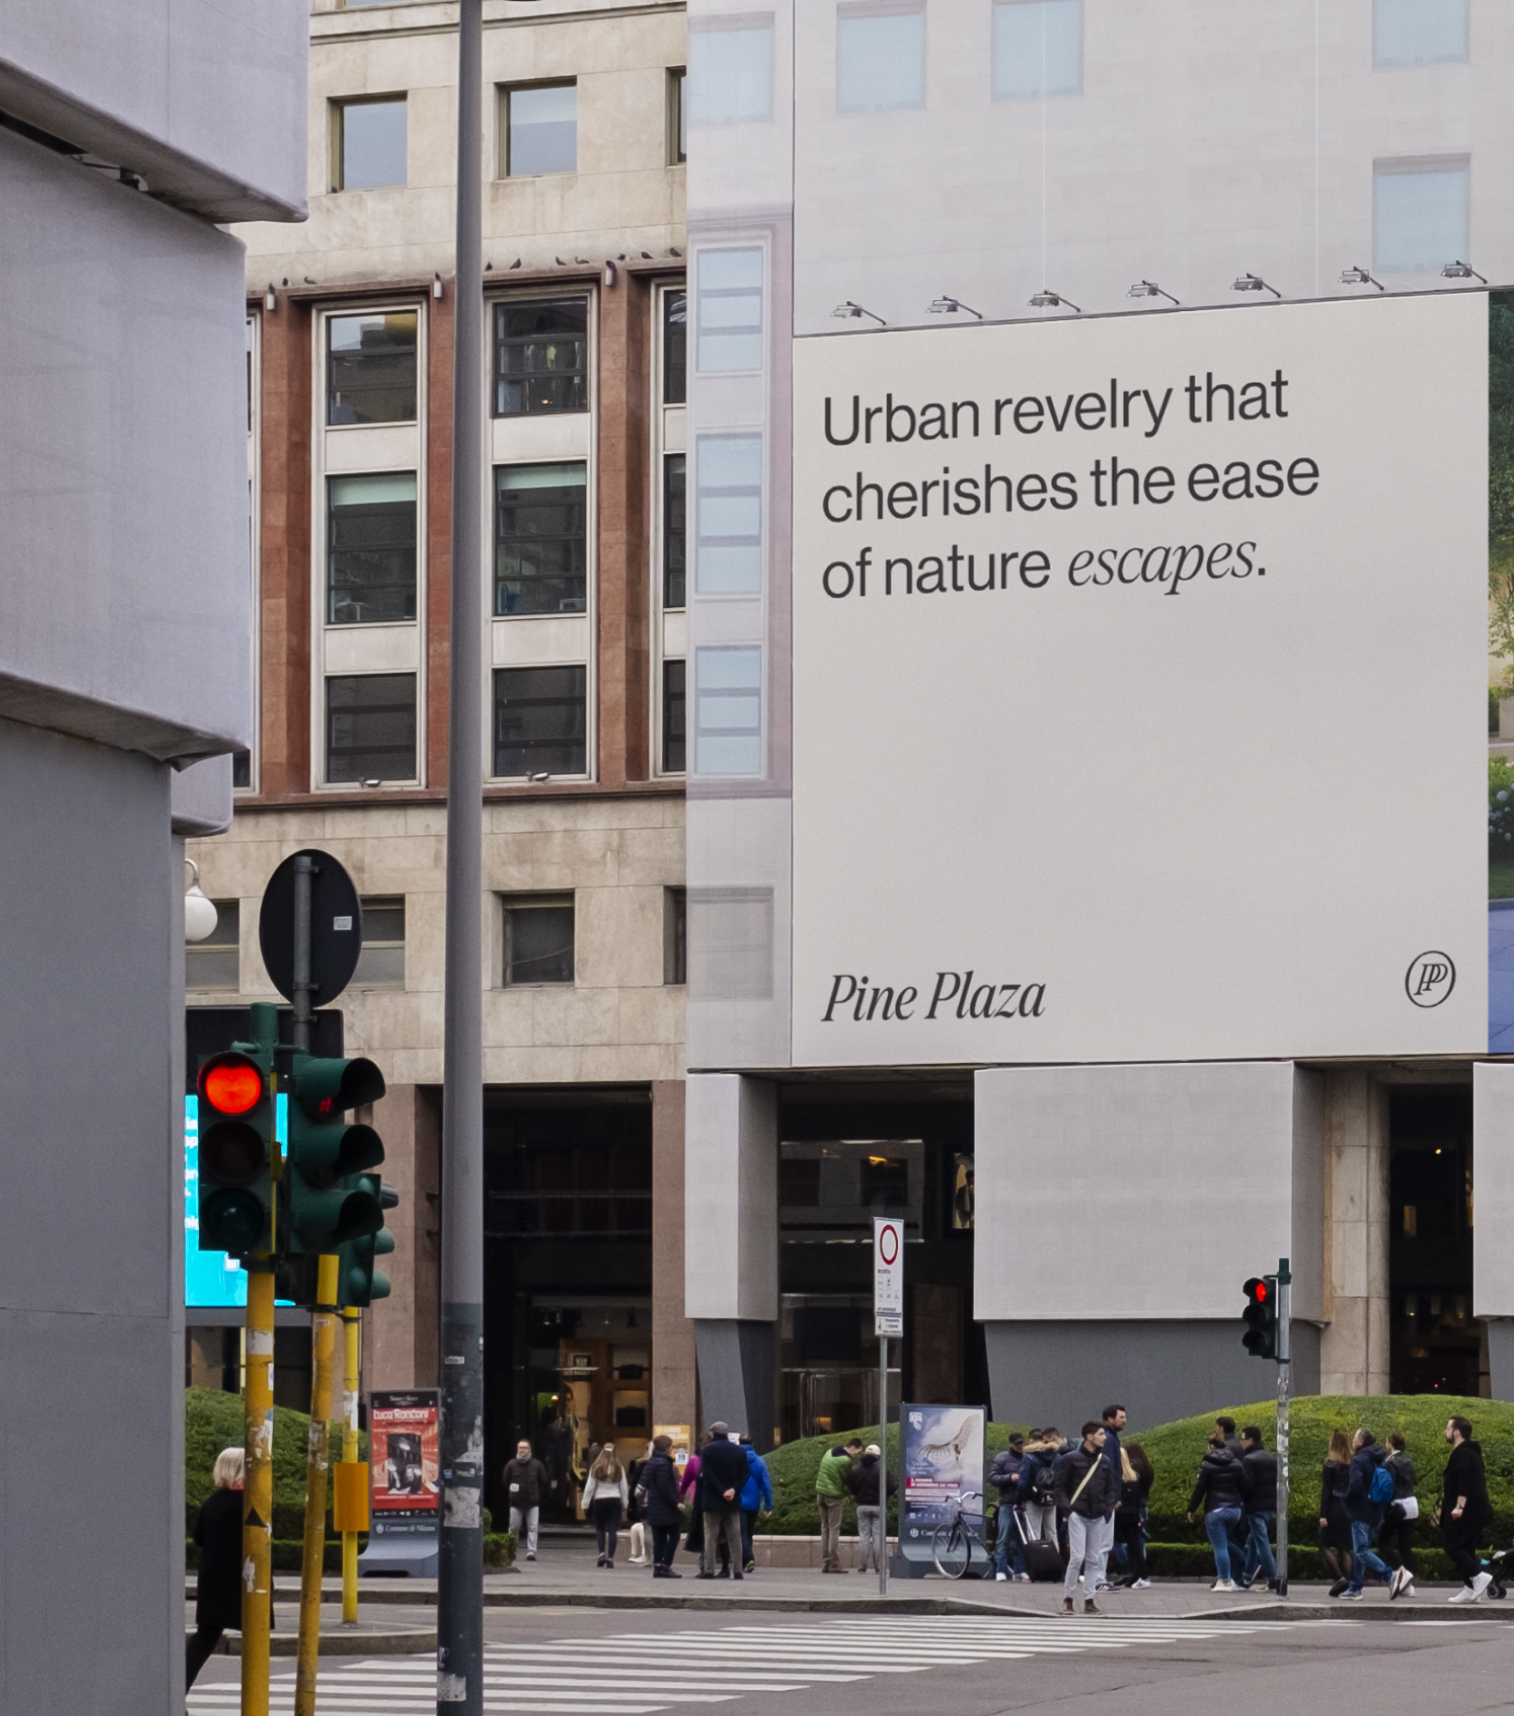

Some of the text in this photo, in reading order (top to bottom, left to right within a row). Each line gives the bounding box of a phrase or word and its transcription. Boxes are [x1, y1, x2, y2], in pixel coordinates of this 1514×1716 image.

[824, 369, 1289, 446] Urban revelry that
[822, 455, 1320, 523] cherishes the ease
[822, 541, 1266, 599] of nature escapes.
[820, 970, 1046, 1022] Pine Plaza
